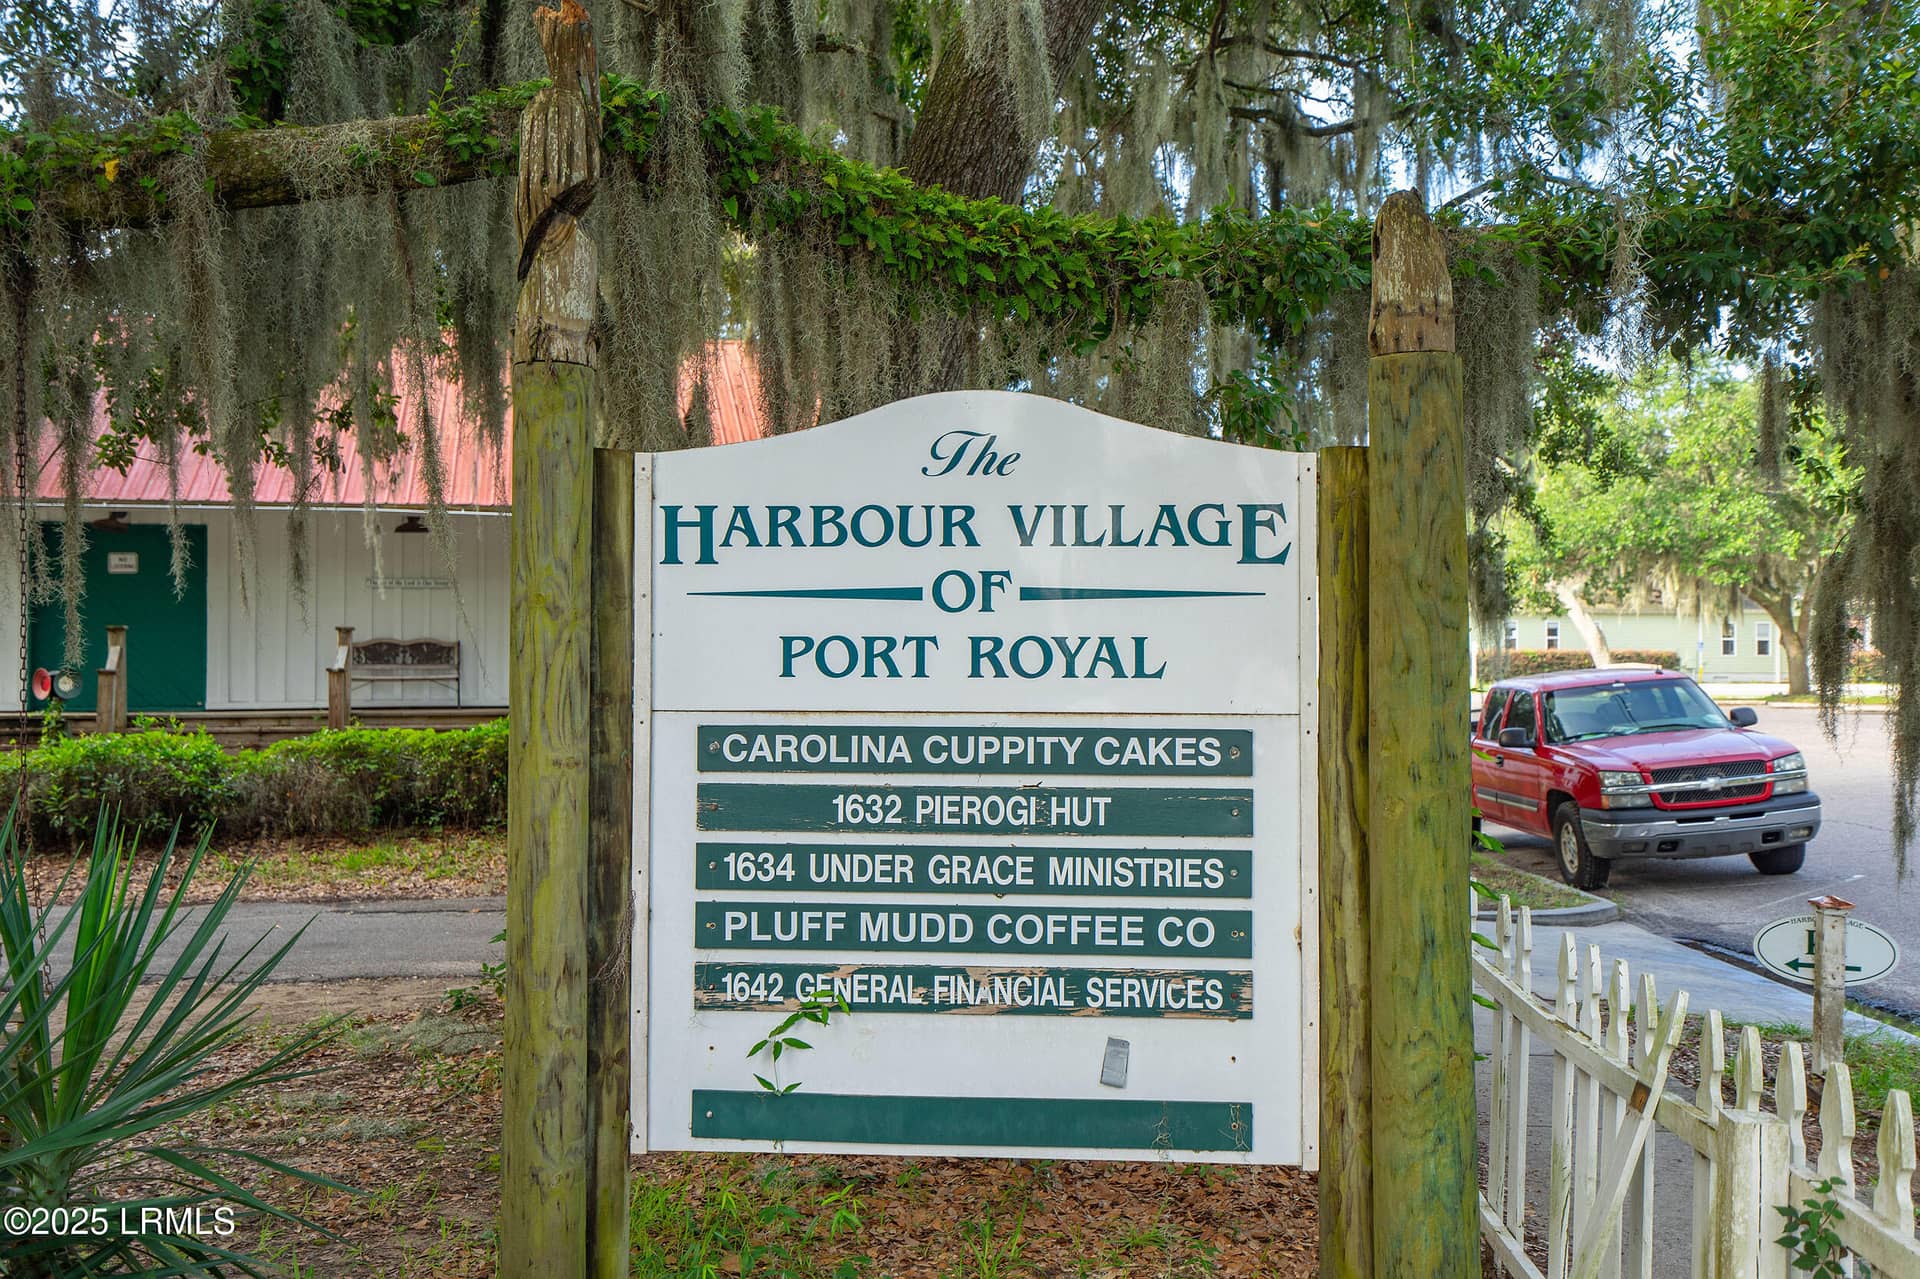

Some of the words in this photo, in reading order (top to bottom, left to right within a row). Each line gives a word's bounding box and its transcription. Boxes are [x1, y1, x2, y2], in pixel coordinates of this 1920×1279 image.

[921, 430, 1021, 477] The
[659, 504, 981, 565] HARBOUR
[1006, 502, 1292, 566] VILLAGE
[931, 569, 1013, 614] OF
[778, 635, 940, 679] PORT
[967, 635, 1168, 680] ROYAL
[722, 733, 913, 763] CAROLINA
[923, 735, 1084, 766] CUPPITY
[1094, 736, 1222, 768] CAKES
[832, 794, 902, 825] 1632
[915, 795, 1037, 827] PIEROGI
[1050, 796, 1113, 827] HUT
[723, 852, 796, 883] 1634
[809, 853, 914, 884] UNDER
[928, 854, 1035, 886] GRACE
[1048, 856, 1225, 889] MINISTRIES
[724, 910, 847, 942] PLUFF
[859, 911, 975, 944] MUDD
[986, 913, 1145, 947] COFFEE
[1157, 916, 1216, 949] CO
[721, 972, 784, 1002] 1642
[795, 973, 922, 1005] GENERAL
[933, 975, 1075, 1007] FINANCIAL
[1086, 977, 1224, 1010] SERVICES
